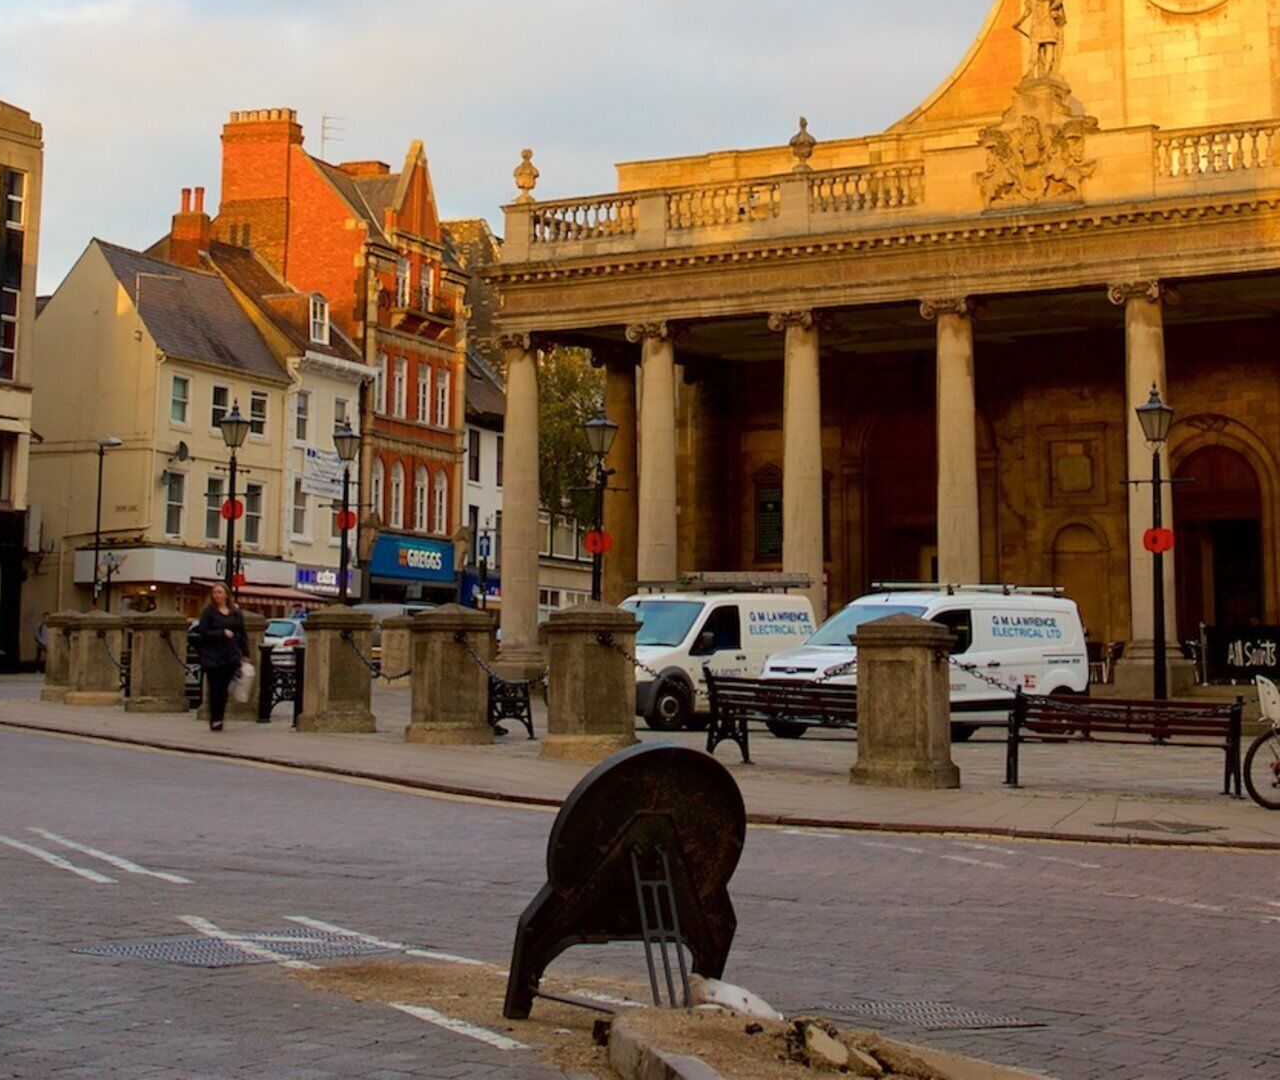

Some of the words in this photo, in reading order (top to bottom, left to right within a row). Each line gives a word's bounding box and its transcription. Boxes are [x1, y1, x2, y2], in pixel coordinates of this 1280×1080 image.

[407, 549, 443, 570] GREGGS
[757, 612, 765, 622] M
[992, 615, 1000, 626] G
[1001, 616, 1010, 626] M
[1012, 616, 1058, 628] LAWRENCE
[749, 624, 798, 636] ELECTRICAL
[800, 625, 815, 635] LTD
[992, 626, 1044, 638] ELECTRICAL
[1046, 628, 1062, 639] LTD
[1227, 641, 1244, 667] All
[1245, 639, 1277, 667] Saints
